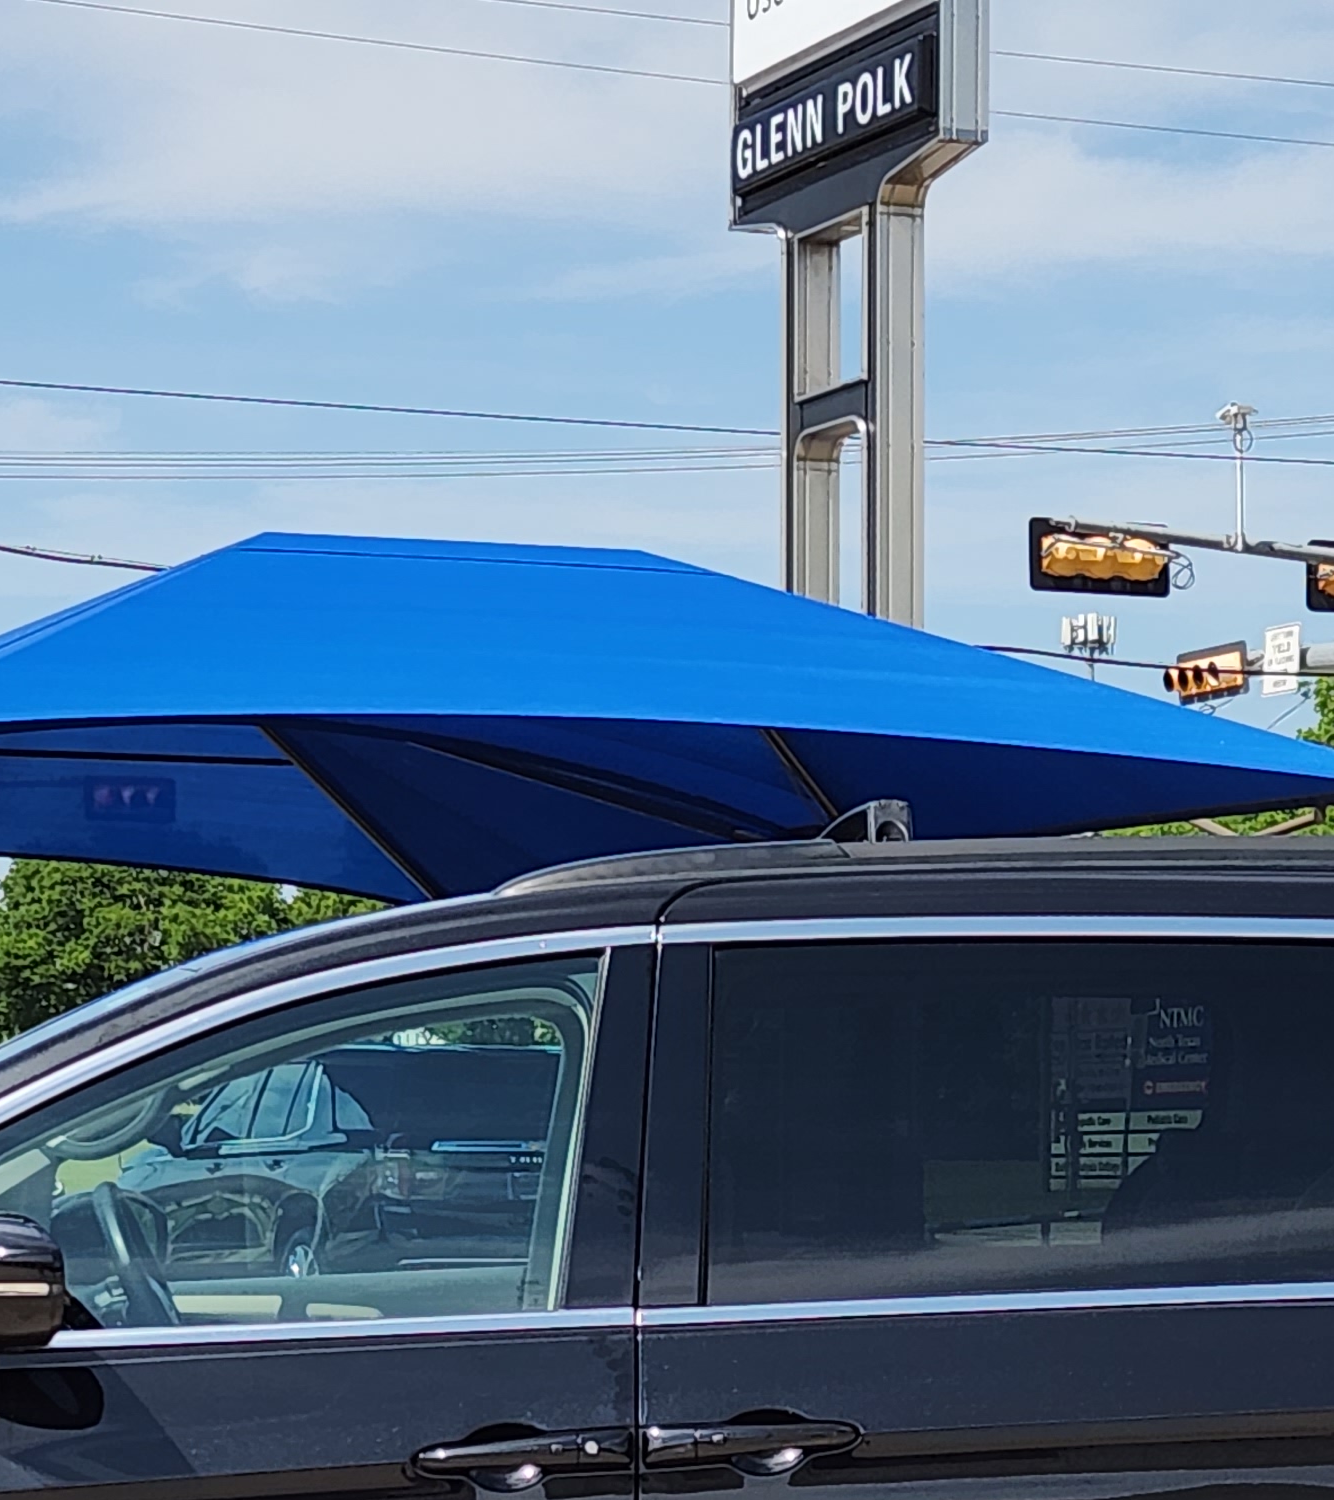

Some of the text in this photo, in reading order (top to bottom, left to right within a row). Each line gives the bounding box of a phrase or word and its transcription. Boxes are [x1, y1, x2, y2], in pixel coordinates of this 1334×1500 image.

[736, 52, 914, 180] GLENN POLK
[1160, 1005, 1205, 1029] NTMC
